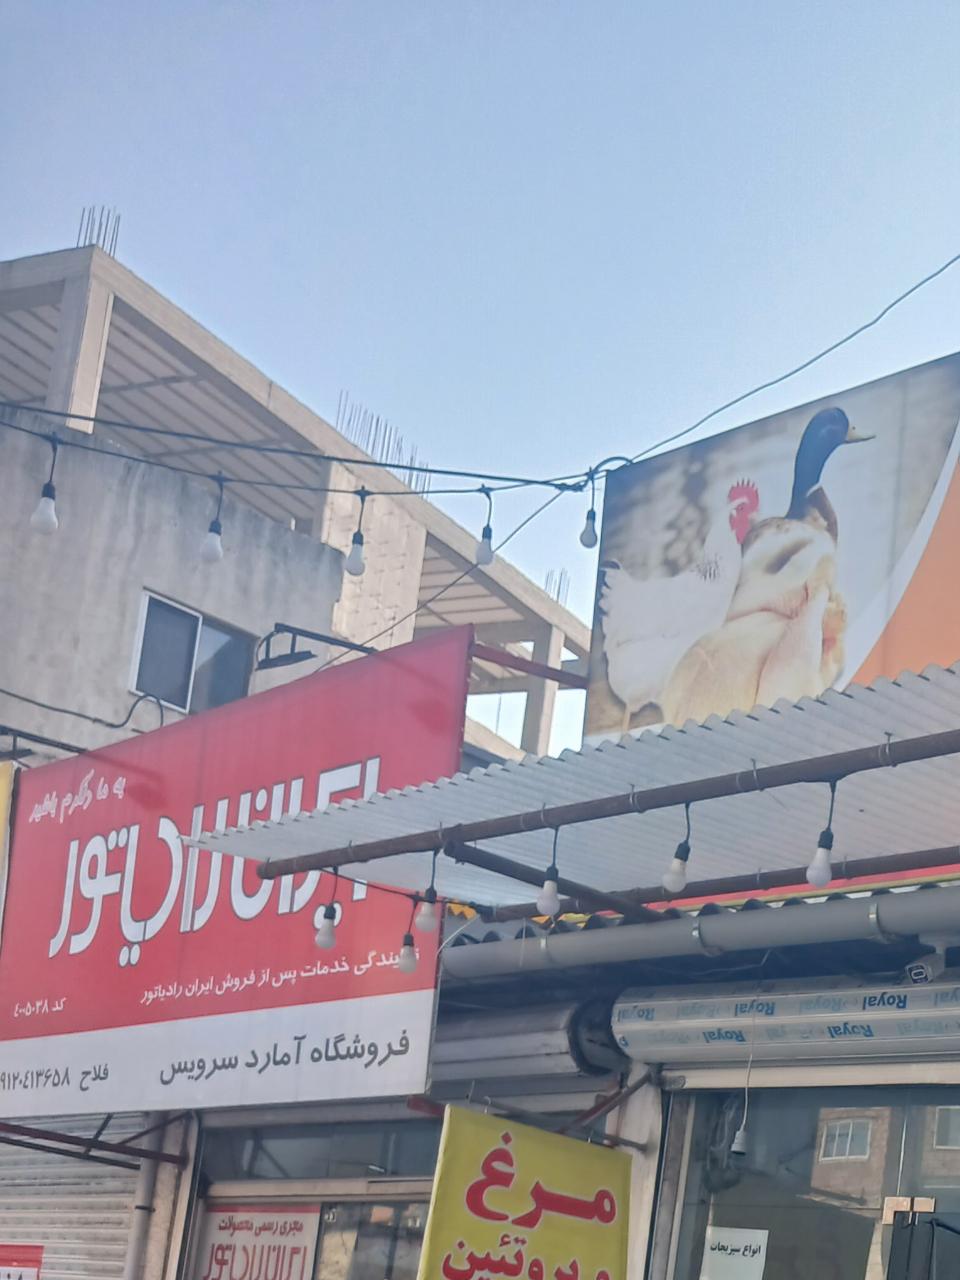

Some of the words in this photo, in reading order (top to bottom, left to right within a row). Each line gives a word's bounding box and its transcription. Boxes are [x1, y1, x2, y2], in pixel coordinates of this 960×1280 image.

[96, 777, 110, 800] ما
[300, 955, 350, 977] خدمات
[353, 947, 421, 977] نیندگی
[185, 976, 214, 998] ایران
[215, 970, 256, 995] فروش
[257, 968, 270, 987] از
[271, 968, 297, 988] پس
[140, 981, 183, 1005] رادیاتور
[862, 993, 908, 1010] Royal
[51, 997, 67, 1012] کد
[734, 999, 776, 1017] Royal
[702, 1028, 747, 1044] Royal
[827, 1023, 875, 1039] Royal
[244, 1035, 307, 1075] آمارد
[309, 1029, 411, 1069] فروشگاه
[79, 1063, 109, 1092] فلاح
[159, 1054, 239, 1086] سرویس
[464, 1130, 618, 1230] مرغ
[254, 1220, 278, 1237] رسمی
[742, 1244, 761, 1257] انواع
